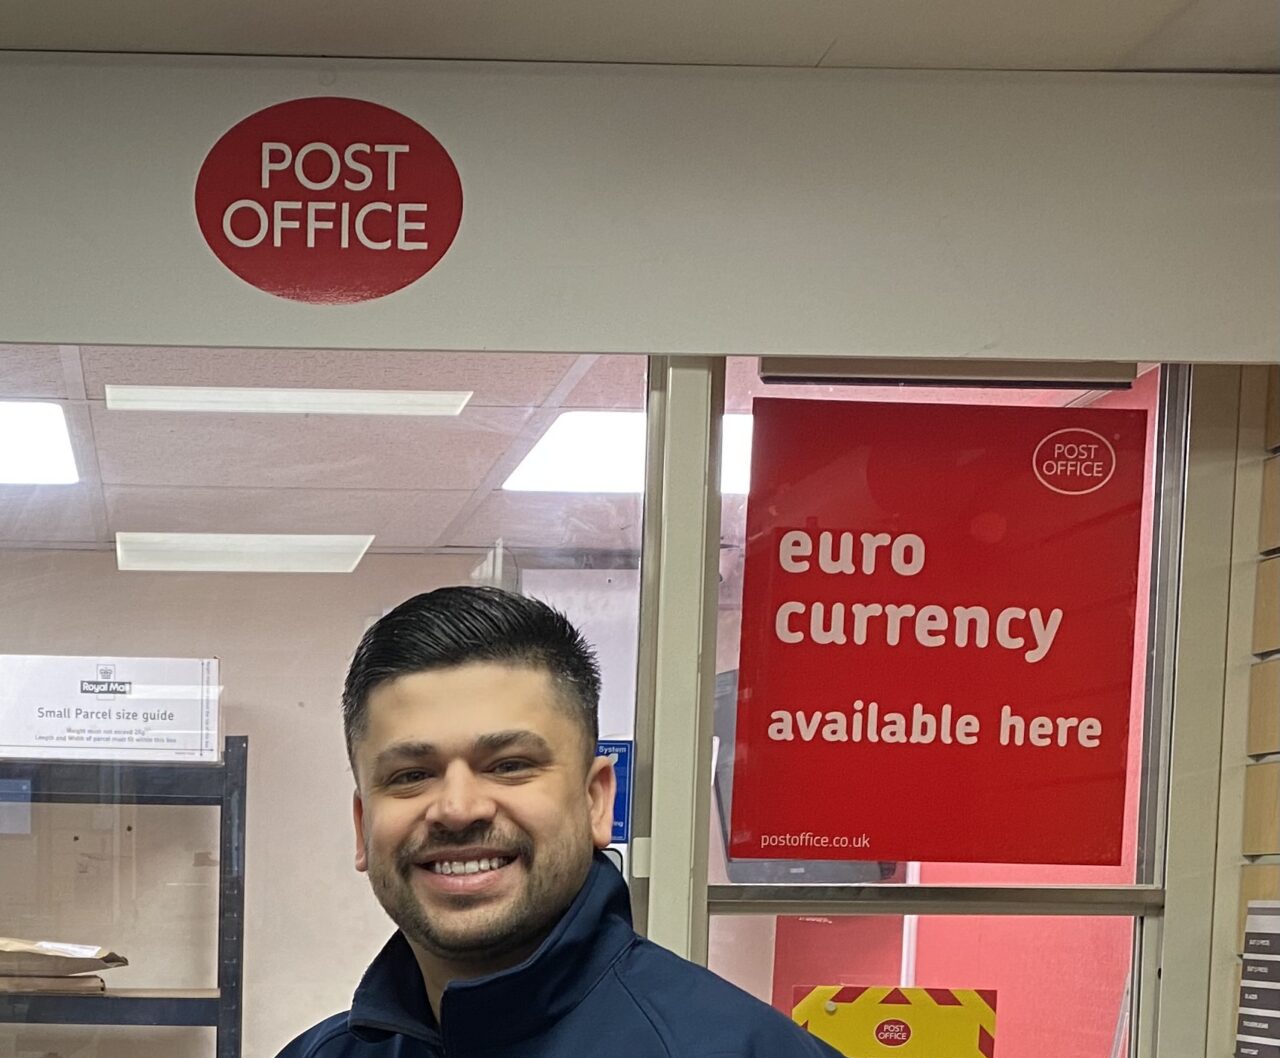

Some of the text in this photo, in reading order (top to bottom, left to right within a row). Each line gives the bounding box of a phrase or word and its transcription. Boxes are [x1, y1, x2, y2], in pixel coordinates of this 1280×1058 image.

[261, 142, 410, 192] POST
[222, 199, 429, 251] OFFICE
[1053, 443, 1099, 460] POST
[1042, 460, 1103, 478] OFFICE
[778, 530, 926, 576] euro
[774, 601, 1064, 664] currency
[81, 682, 108, 693] Royal
[37, 707, 175, 722] Small Parcel size guide
[767, 700, 1103, 748] available here
[598, 745, 628, 754] System
[760, 831, 871, 850] postoffice.co.uk
[877, 1030, 908, 1041] OFFICE
[883, 1023, 905, 1033] POST
